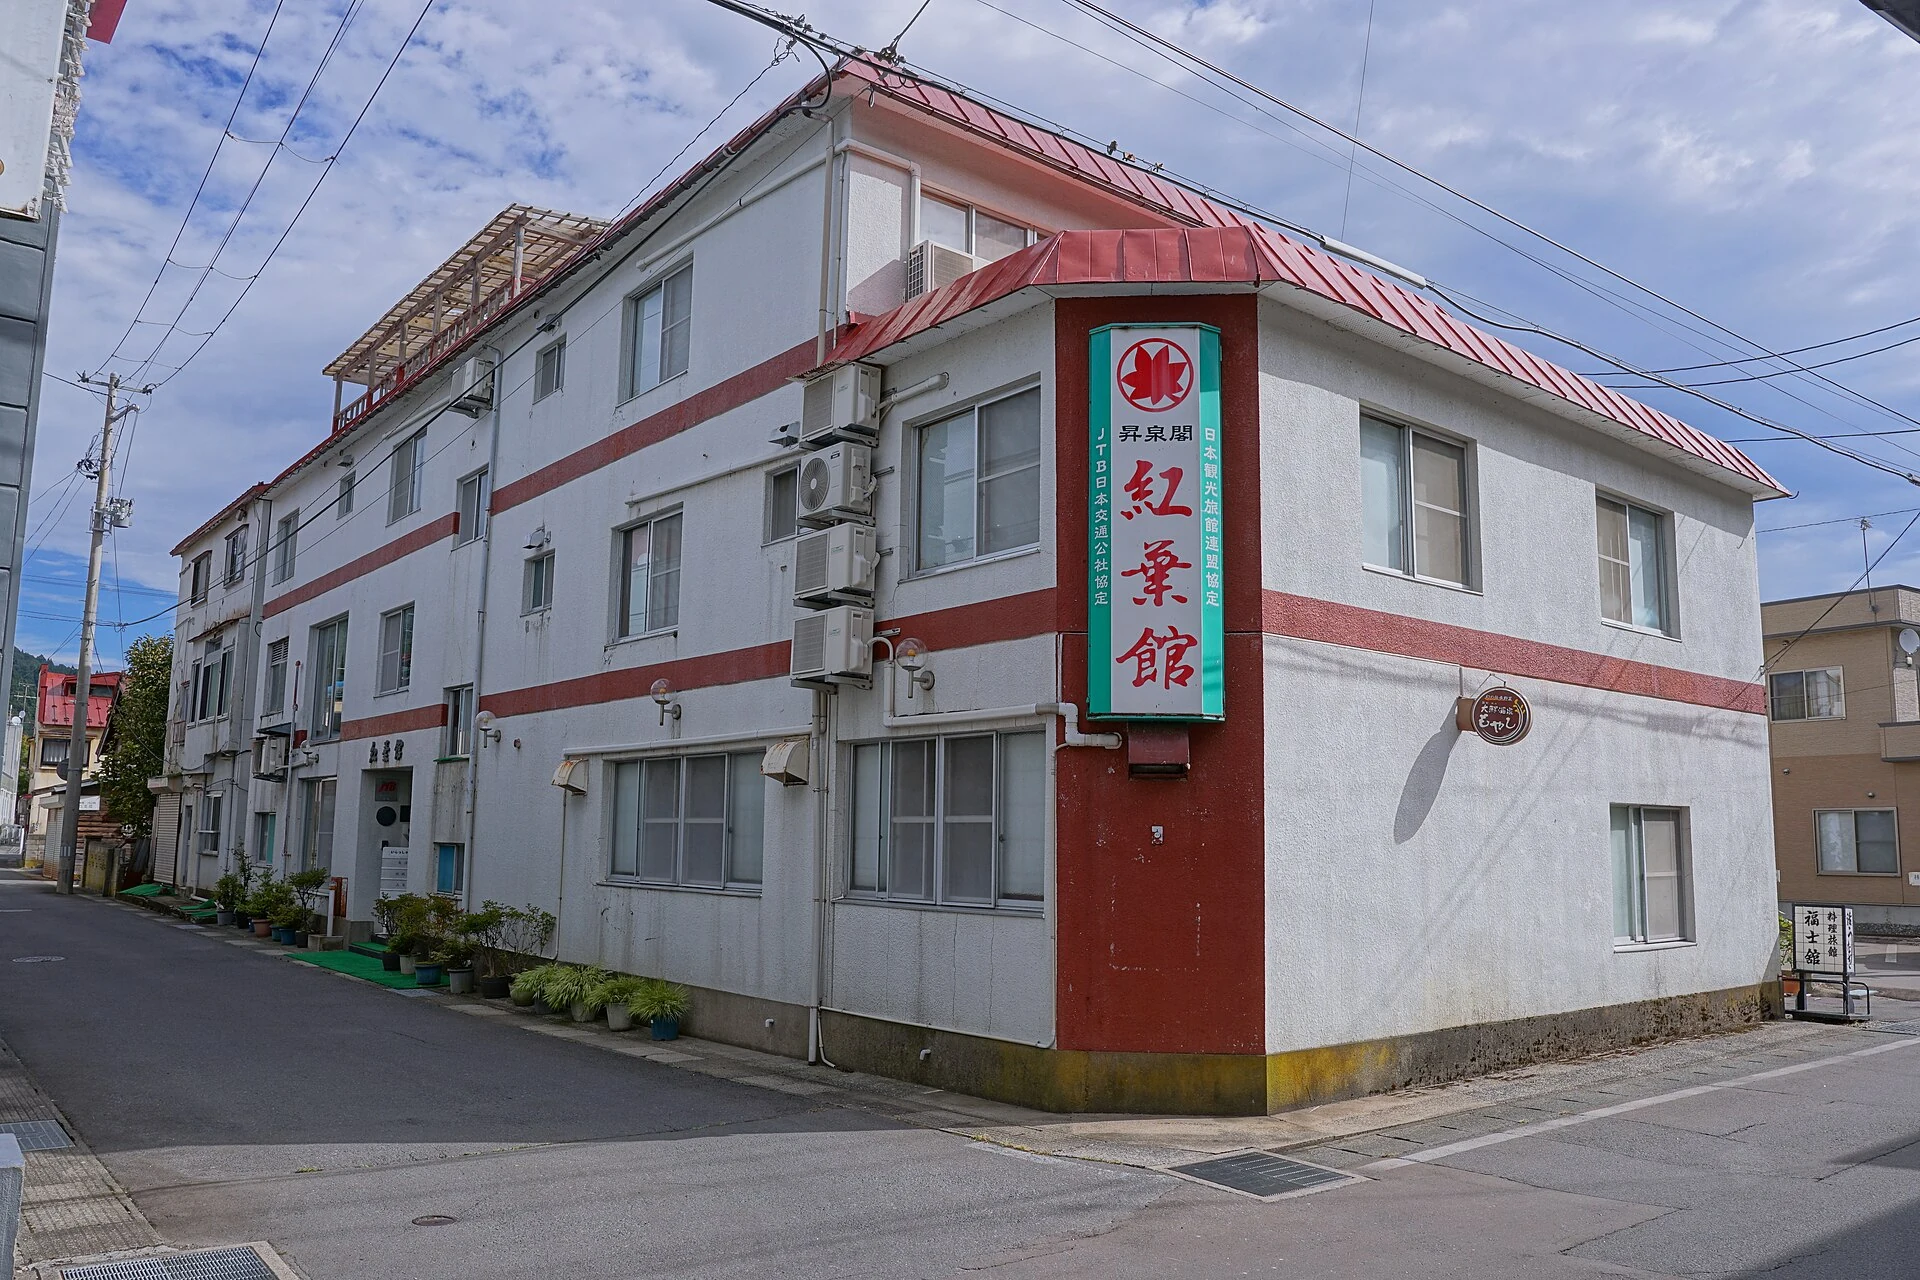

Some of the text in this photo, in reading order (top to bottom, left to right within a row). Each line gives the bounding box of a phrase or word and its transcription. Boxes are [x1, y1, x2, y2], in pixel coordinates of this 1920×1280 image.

[1119, 424, 1193, 442] 昇泉閣
[1094, 427, 1109, 606] JTB日本交通公社協定
[1203, 427, 1220, 607] 日本観光旅館連盟協定
[1115, 459, 1198, 690] 紅葉館
[1479, 714, 1515, 732] もやし
[1827, 911, 1838, 958] 料理旅館
